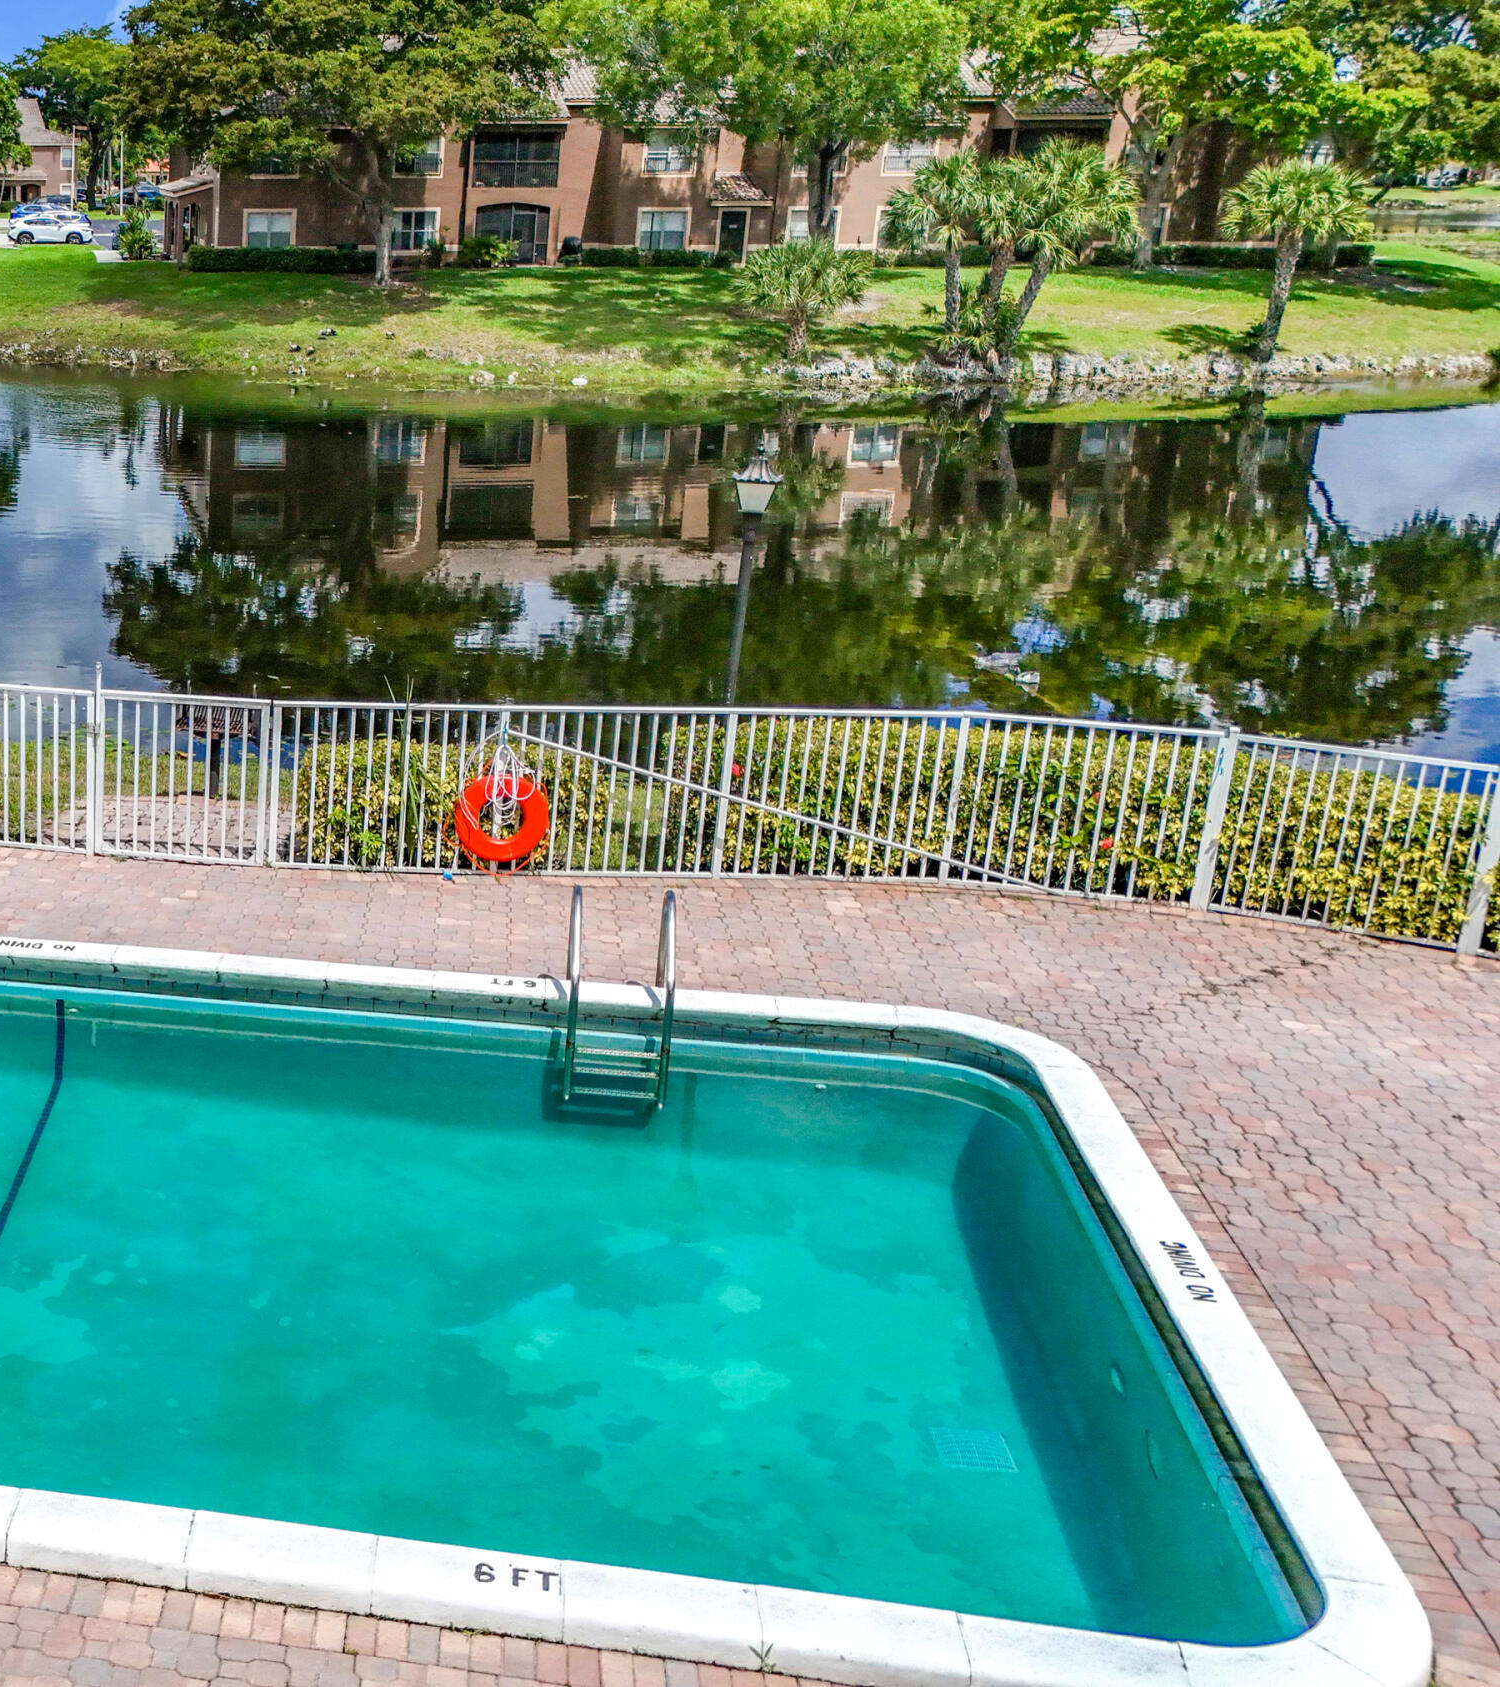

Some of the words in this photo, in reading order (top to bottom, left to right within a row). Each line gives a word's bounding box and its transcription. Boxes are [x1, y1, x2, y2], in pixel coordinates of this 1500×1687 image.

[52, 944, 77, 952] NO
[490, 978, 514, 987] FT
[523, 980, 537, 988] 6
[1159, 1240, 1206, 1279] DIVING
[1185, 1284, 1218, 1303] NO
[474, 1562, 496, 1583] 6
[511, 1567, 560, 1592] FT
